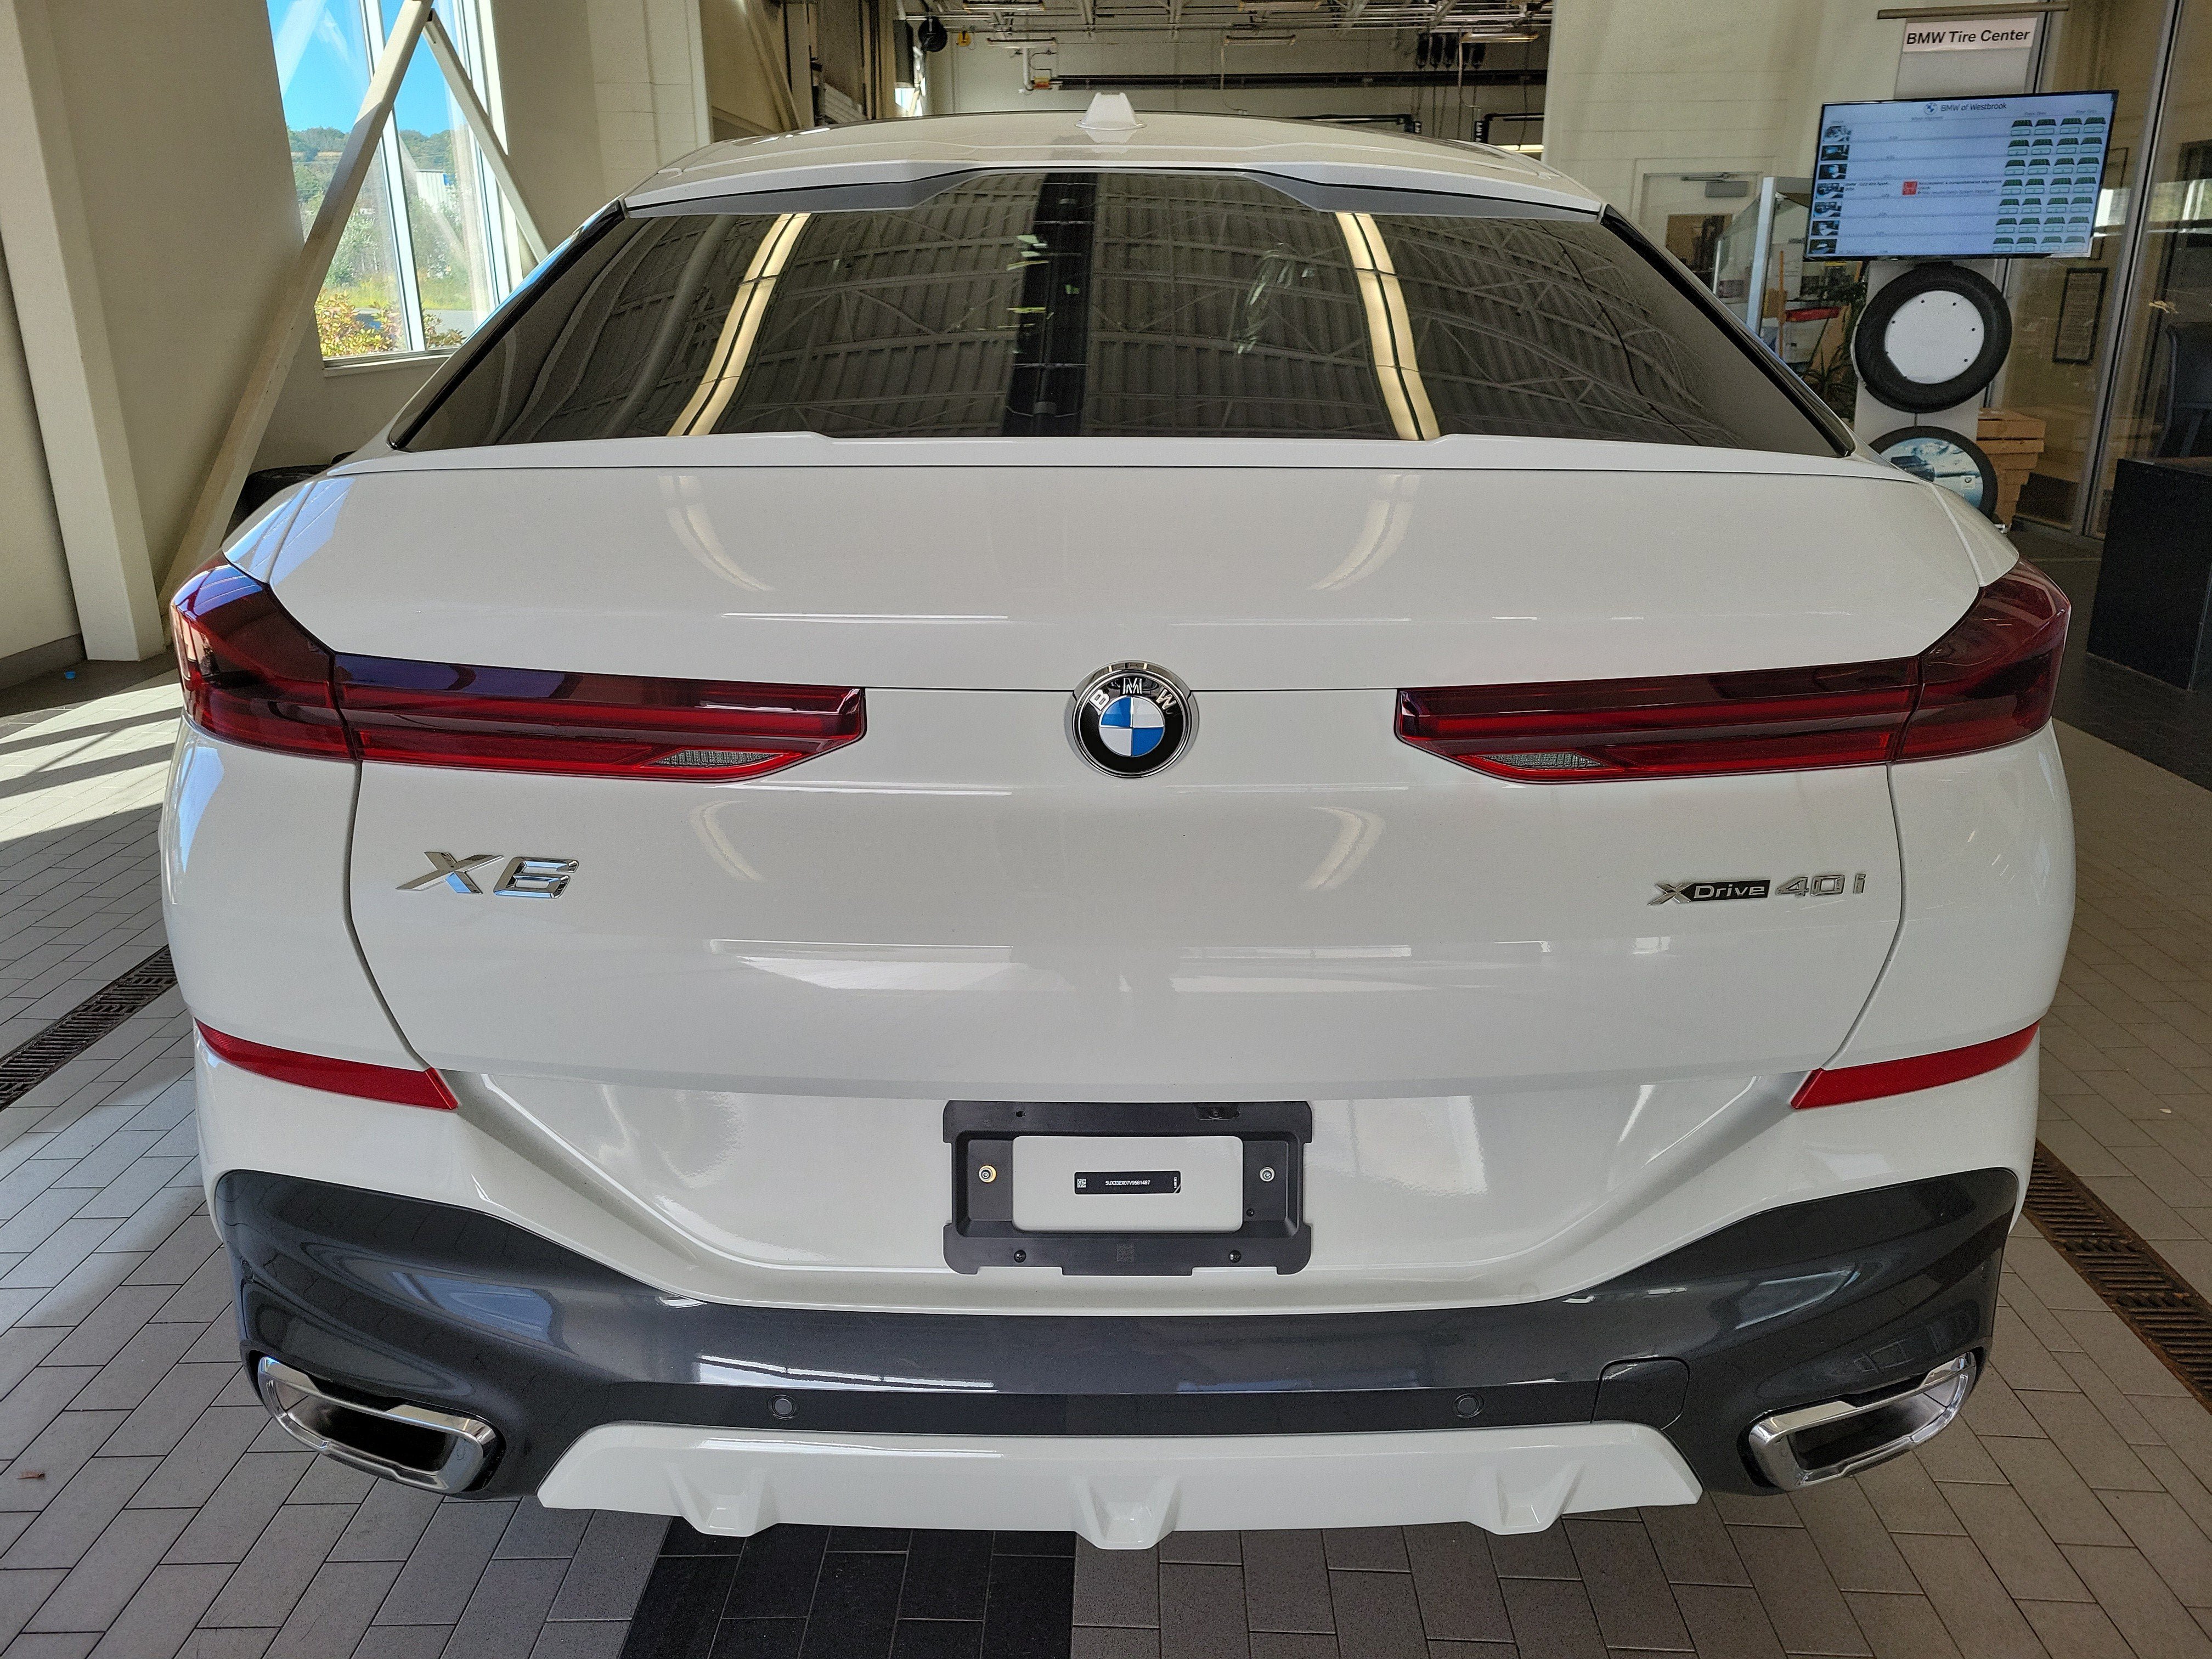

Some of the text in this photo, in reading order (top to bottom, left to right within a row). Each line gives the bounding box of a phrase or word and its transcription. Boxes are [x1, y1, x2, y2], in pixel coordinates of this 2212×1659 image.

[1906, 29, 2031, 44] BMW Tire Center
[1970, 102, 2007, 110] Westbrook
[1088, 677, 1177, 715] BMW
[396, 851, 579, 899] X6
